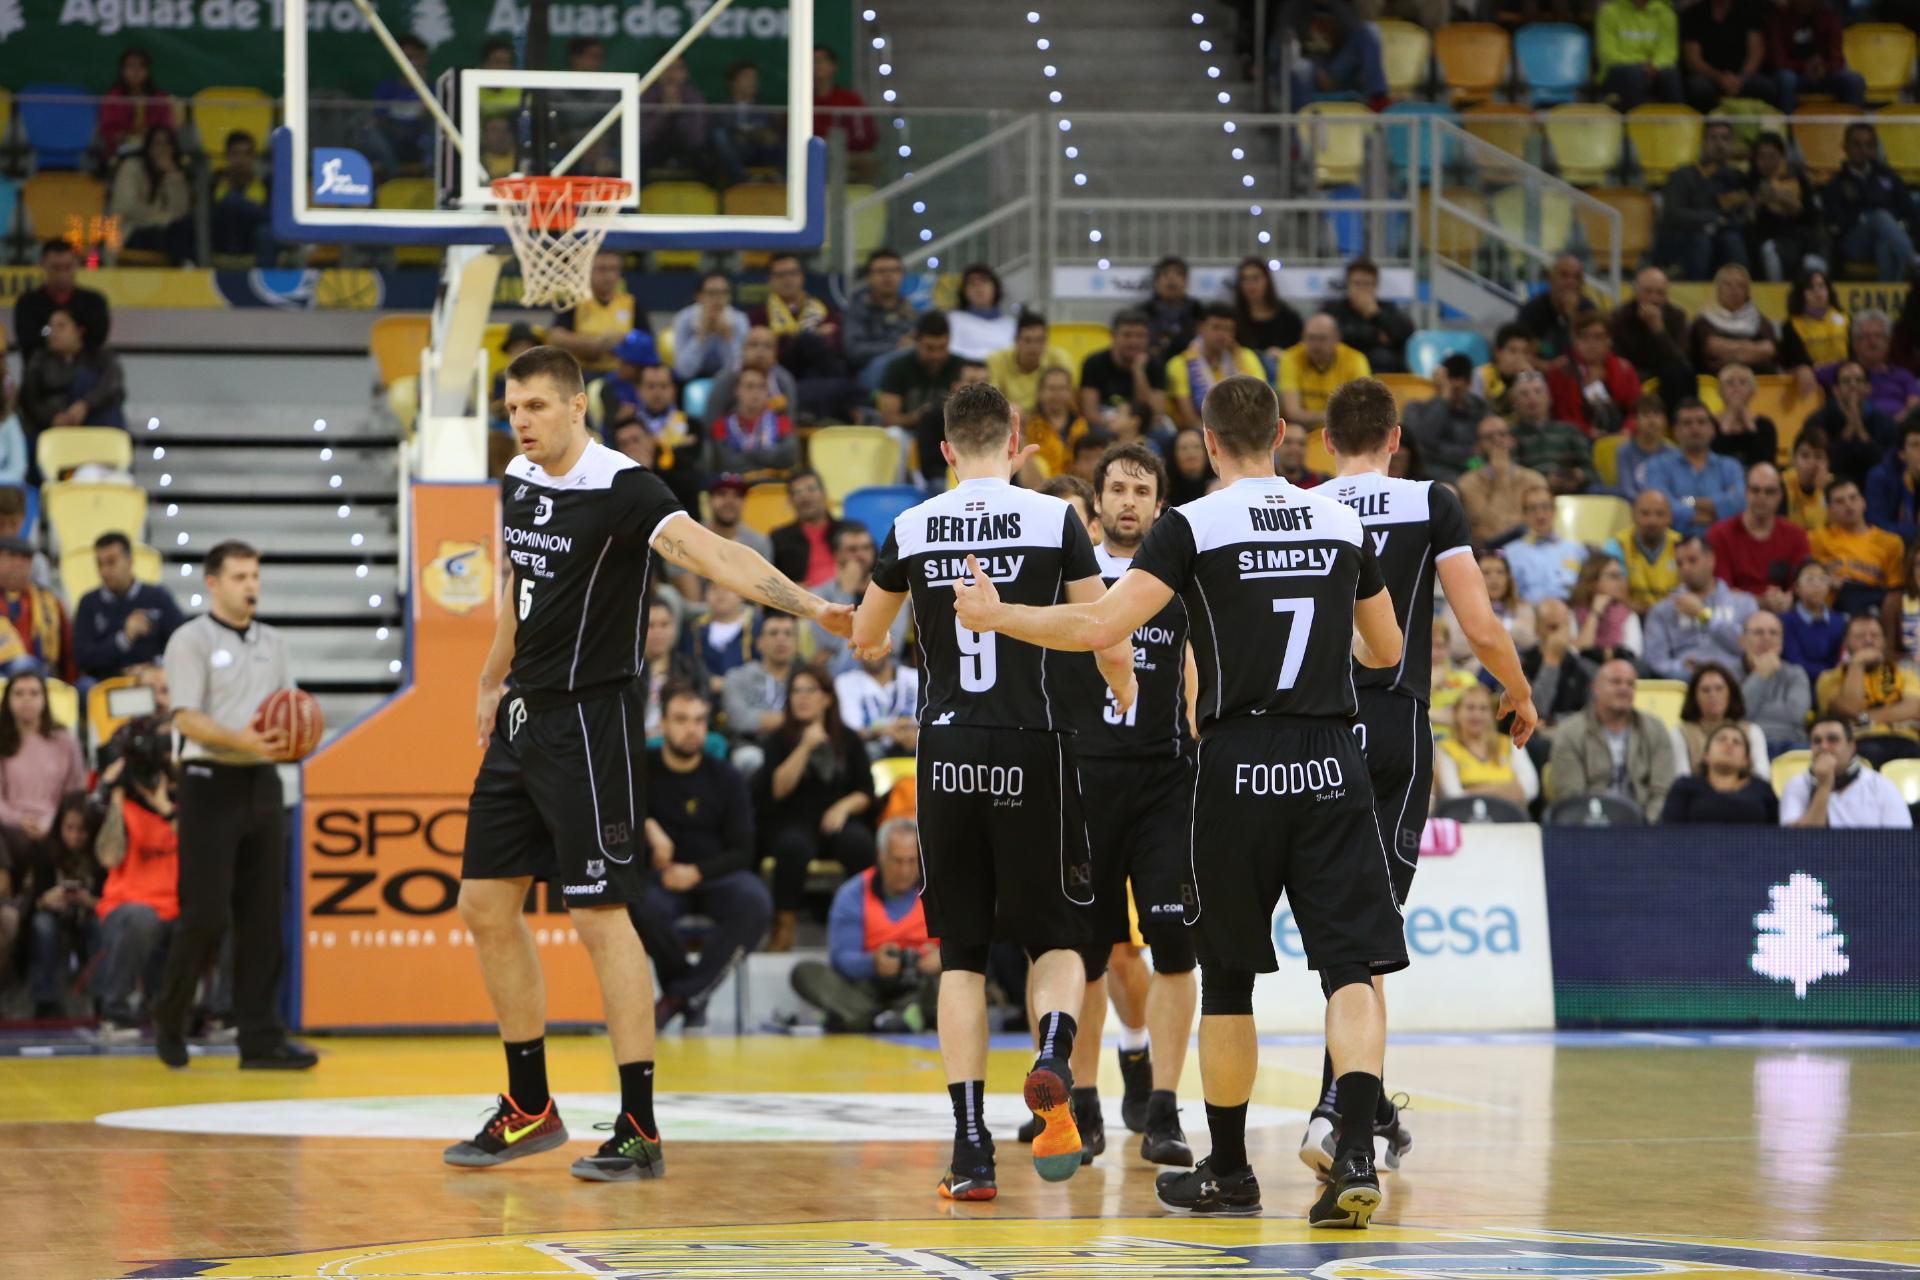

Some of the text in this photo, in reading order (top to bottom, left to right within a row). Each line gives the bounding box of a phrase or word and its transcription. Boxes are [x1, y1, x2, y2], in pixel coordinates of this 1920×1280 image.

[203, 0, 260, 31] de
[623, 0, 681, 36] de
[1248, 506, 1314, 532] RUOFF
[504, 526, 572, 552] DOMINION
[519, 578, 536, 621] 5
[1272, 597, 1315, 690] 7
[1235, 757, 1344, 795] FOODOO
